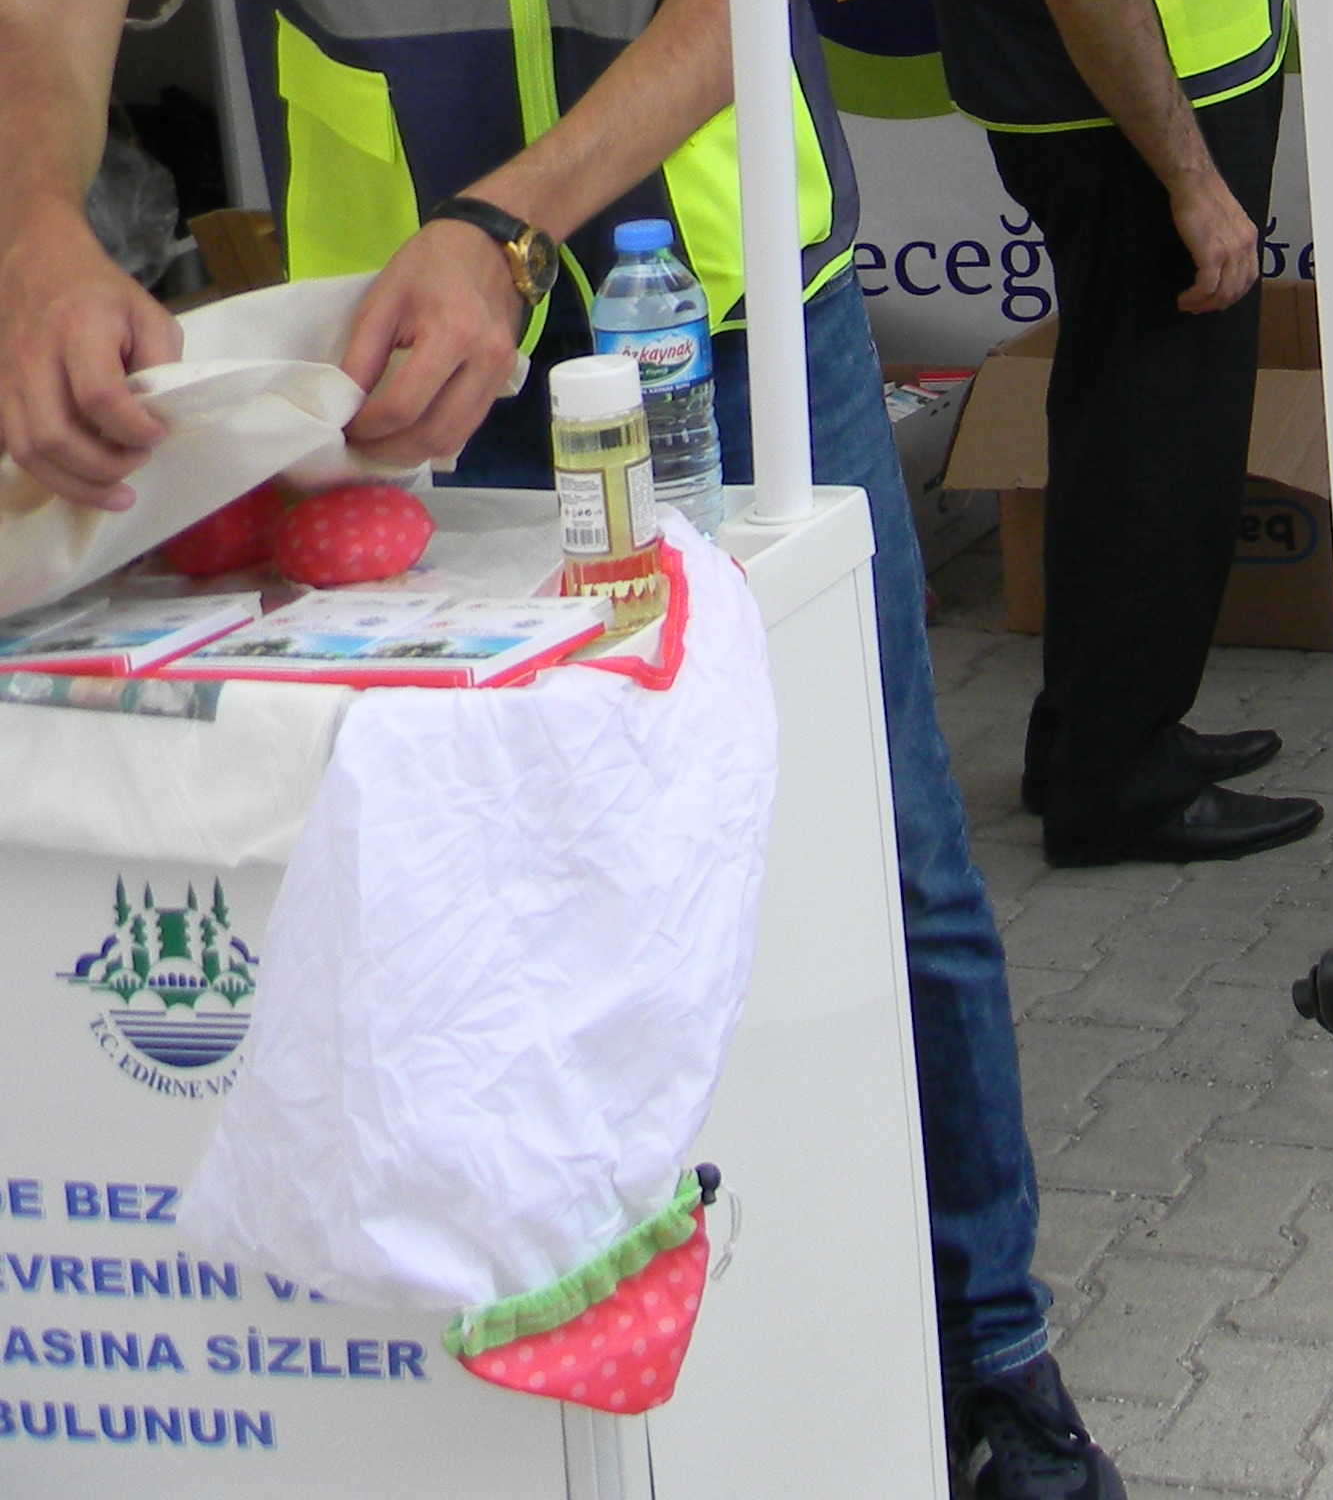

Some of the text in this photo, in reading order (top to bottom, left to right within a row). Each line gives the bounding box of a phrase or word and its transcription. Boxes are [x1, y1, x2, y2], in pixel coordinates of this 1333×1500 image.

[119, 1050, 204, 1099] EDİRNE
[64, 1179, 182, 1225] BEZ
[0, 1249, 242, 1301] VRENİN
[206, 1325, 430, 1382] SİZLER
